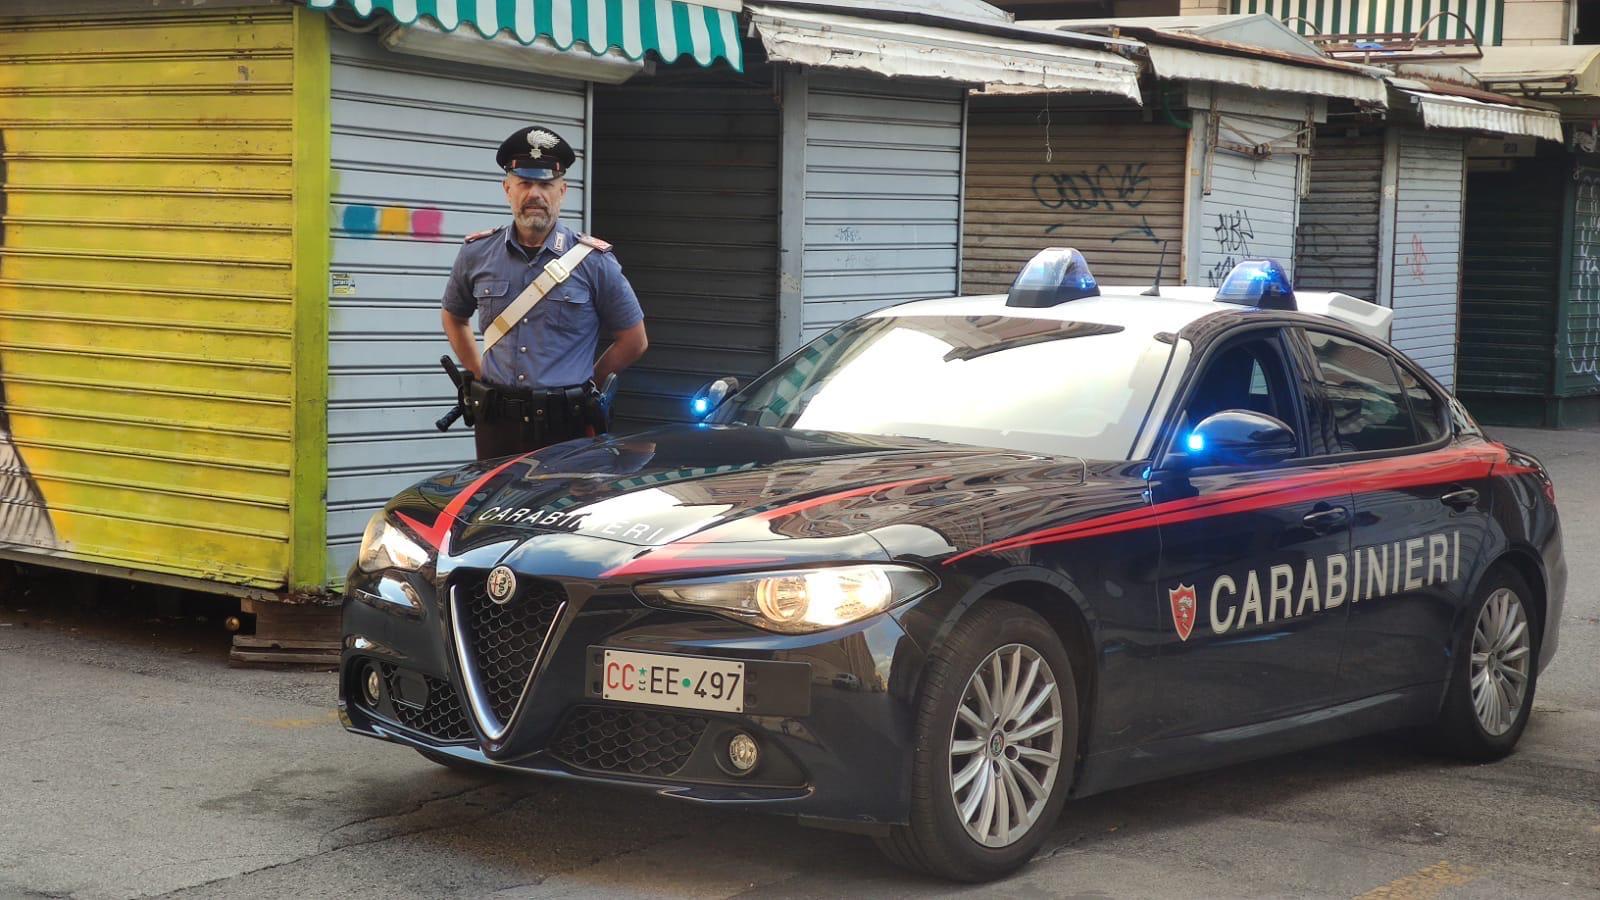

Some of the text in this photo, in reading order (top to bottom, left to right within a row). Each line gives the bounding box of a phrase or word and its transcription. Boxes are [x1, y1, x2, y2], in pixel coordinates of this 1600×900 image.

[479, 507, 664, 541] CARABINERI
[1210, 531, 1460, 634] CARABINIERI
[607, 662, 740, 700] CC EE 497
